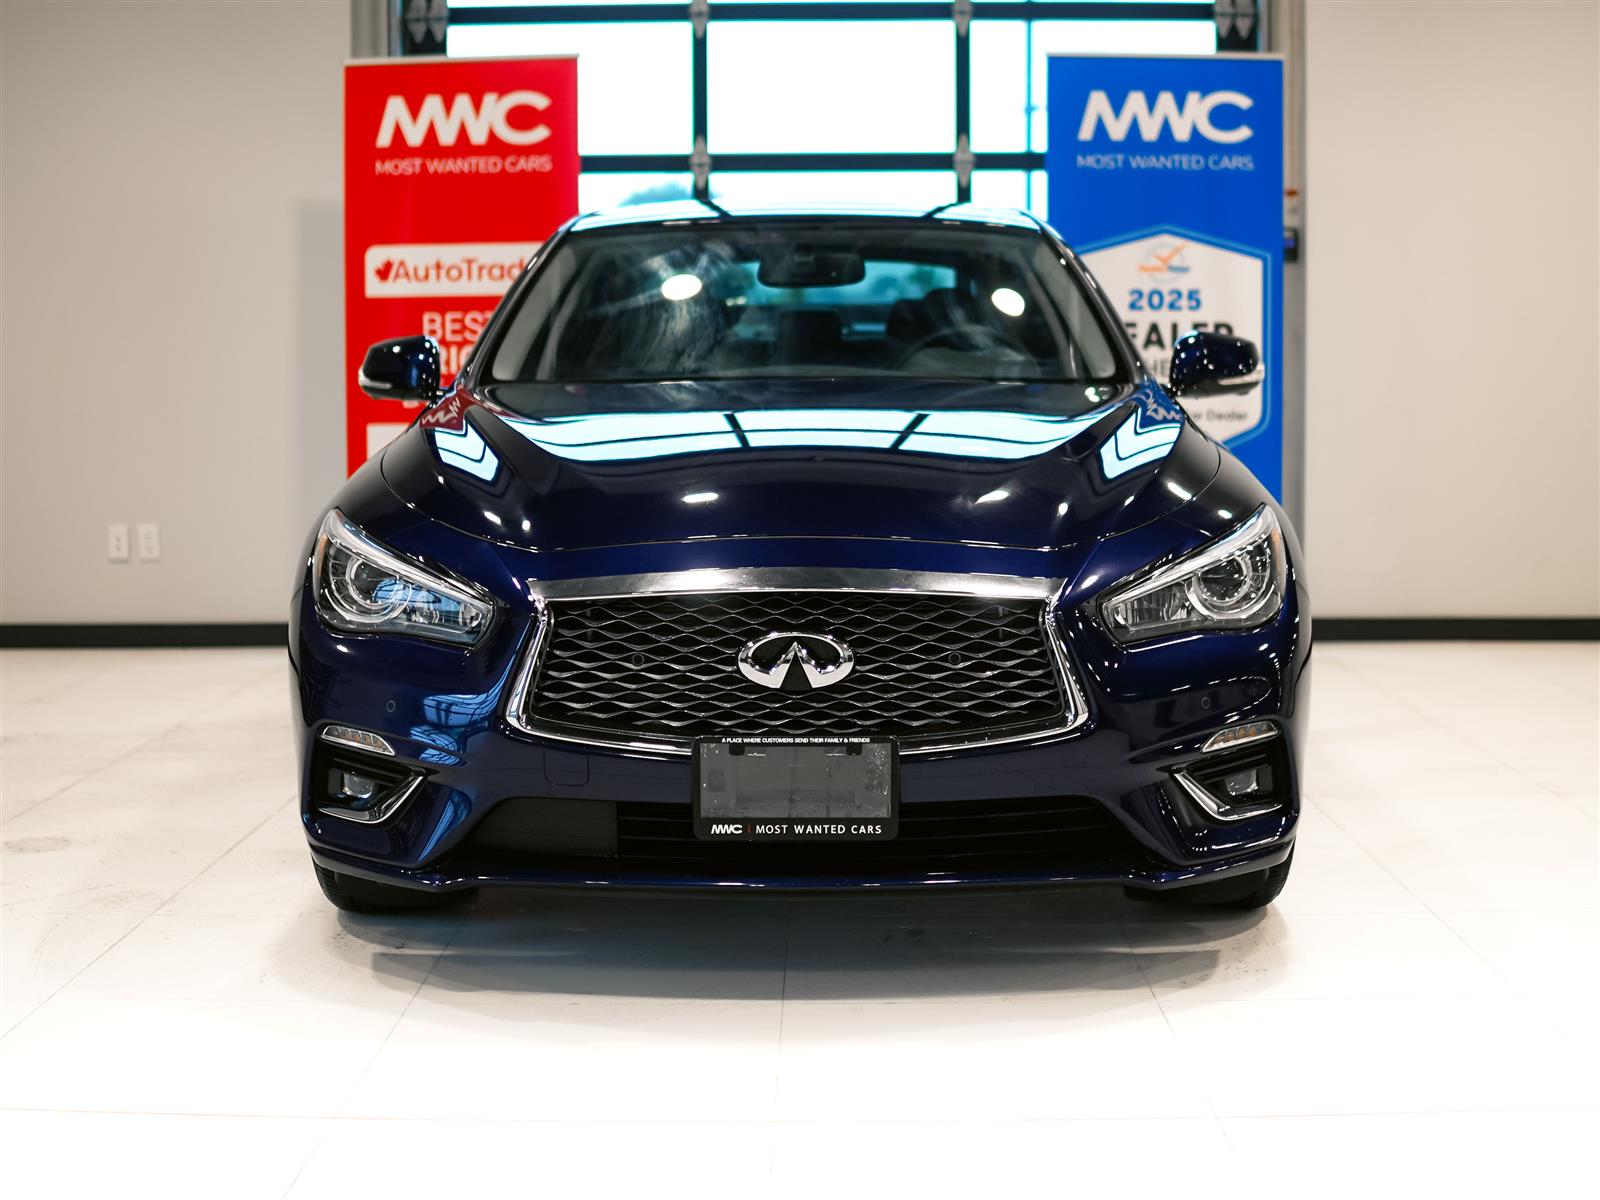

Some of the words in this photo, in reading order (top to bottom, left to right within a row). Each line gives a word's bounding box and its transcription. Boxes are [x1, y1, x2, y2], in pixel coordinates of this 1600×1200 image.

[375, 89, 552, 148] MWC
[1077, 89, 1254, 144] MWC
[375, 157, 422, 175] MOST
[426, 156, 503, 174] WANTED
[504, 154, 552, 173] CARS
[1076, 154, 1124, 169] MOST
[1129, 154, 1204, 170] WANTED
[1208, 155, 1254, 171] CARS
[1128, 289, 1203, 311] 2025
[711, 824, 743, 834] MWC
[755, 824, 788, 834] MOST
[794, 824, 846, 834] WANTED
[851, 824, 882, 834] CARS
